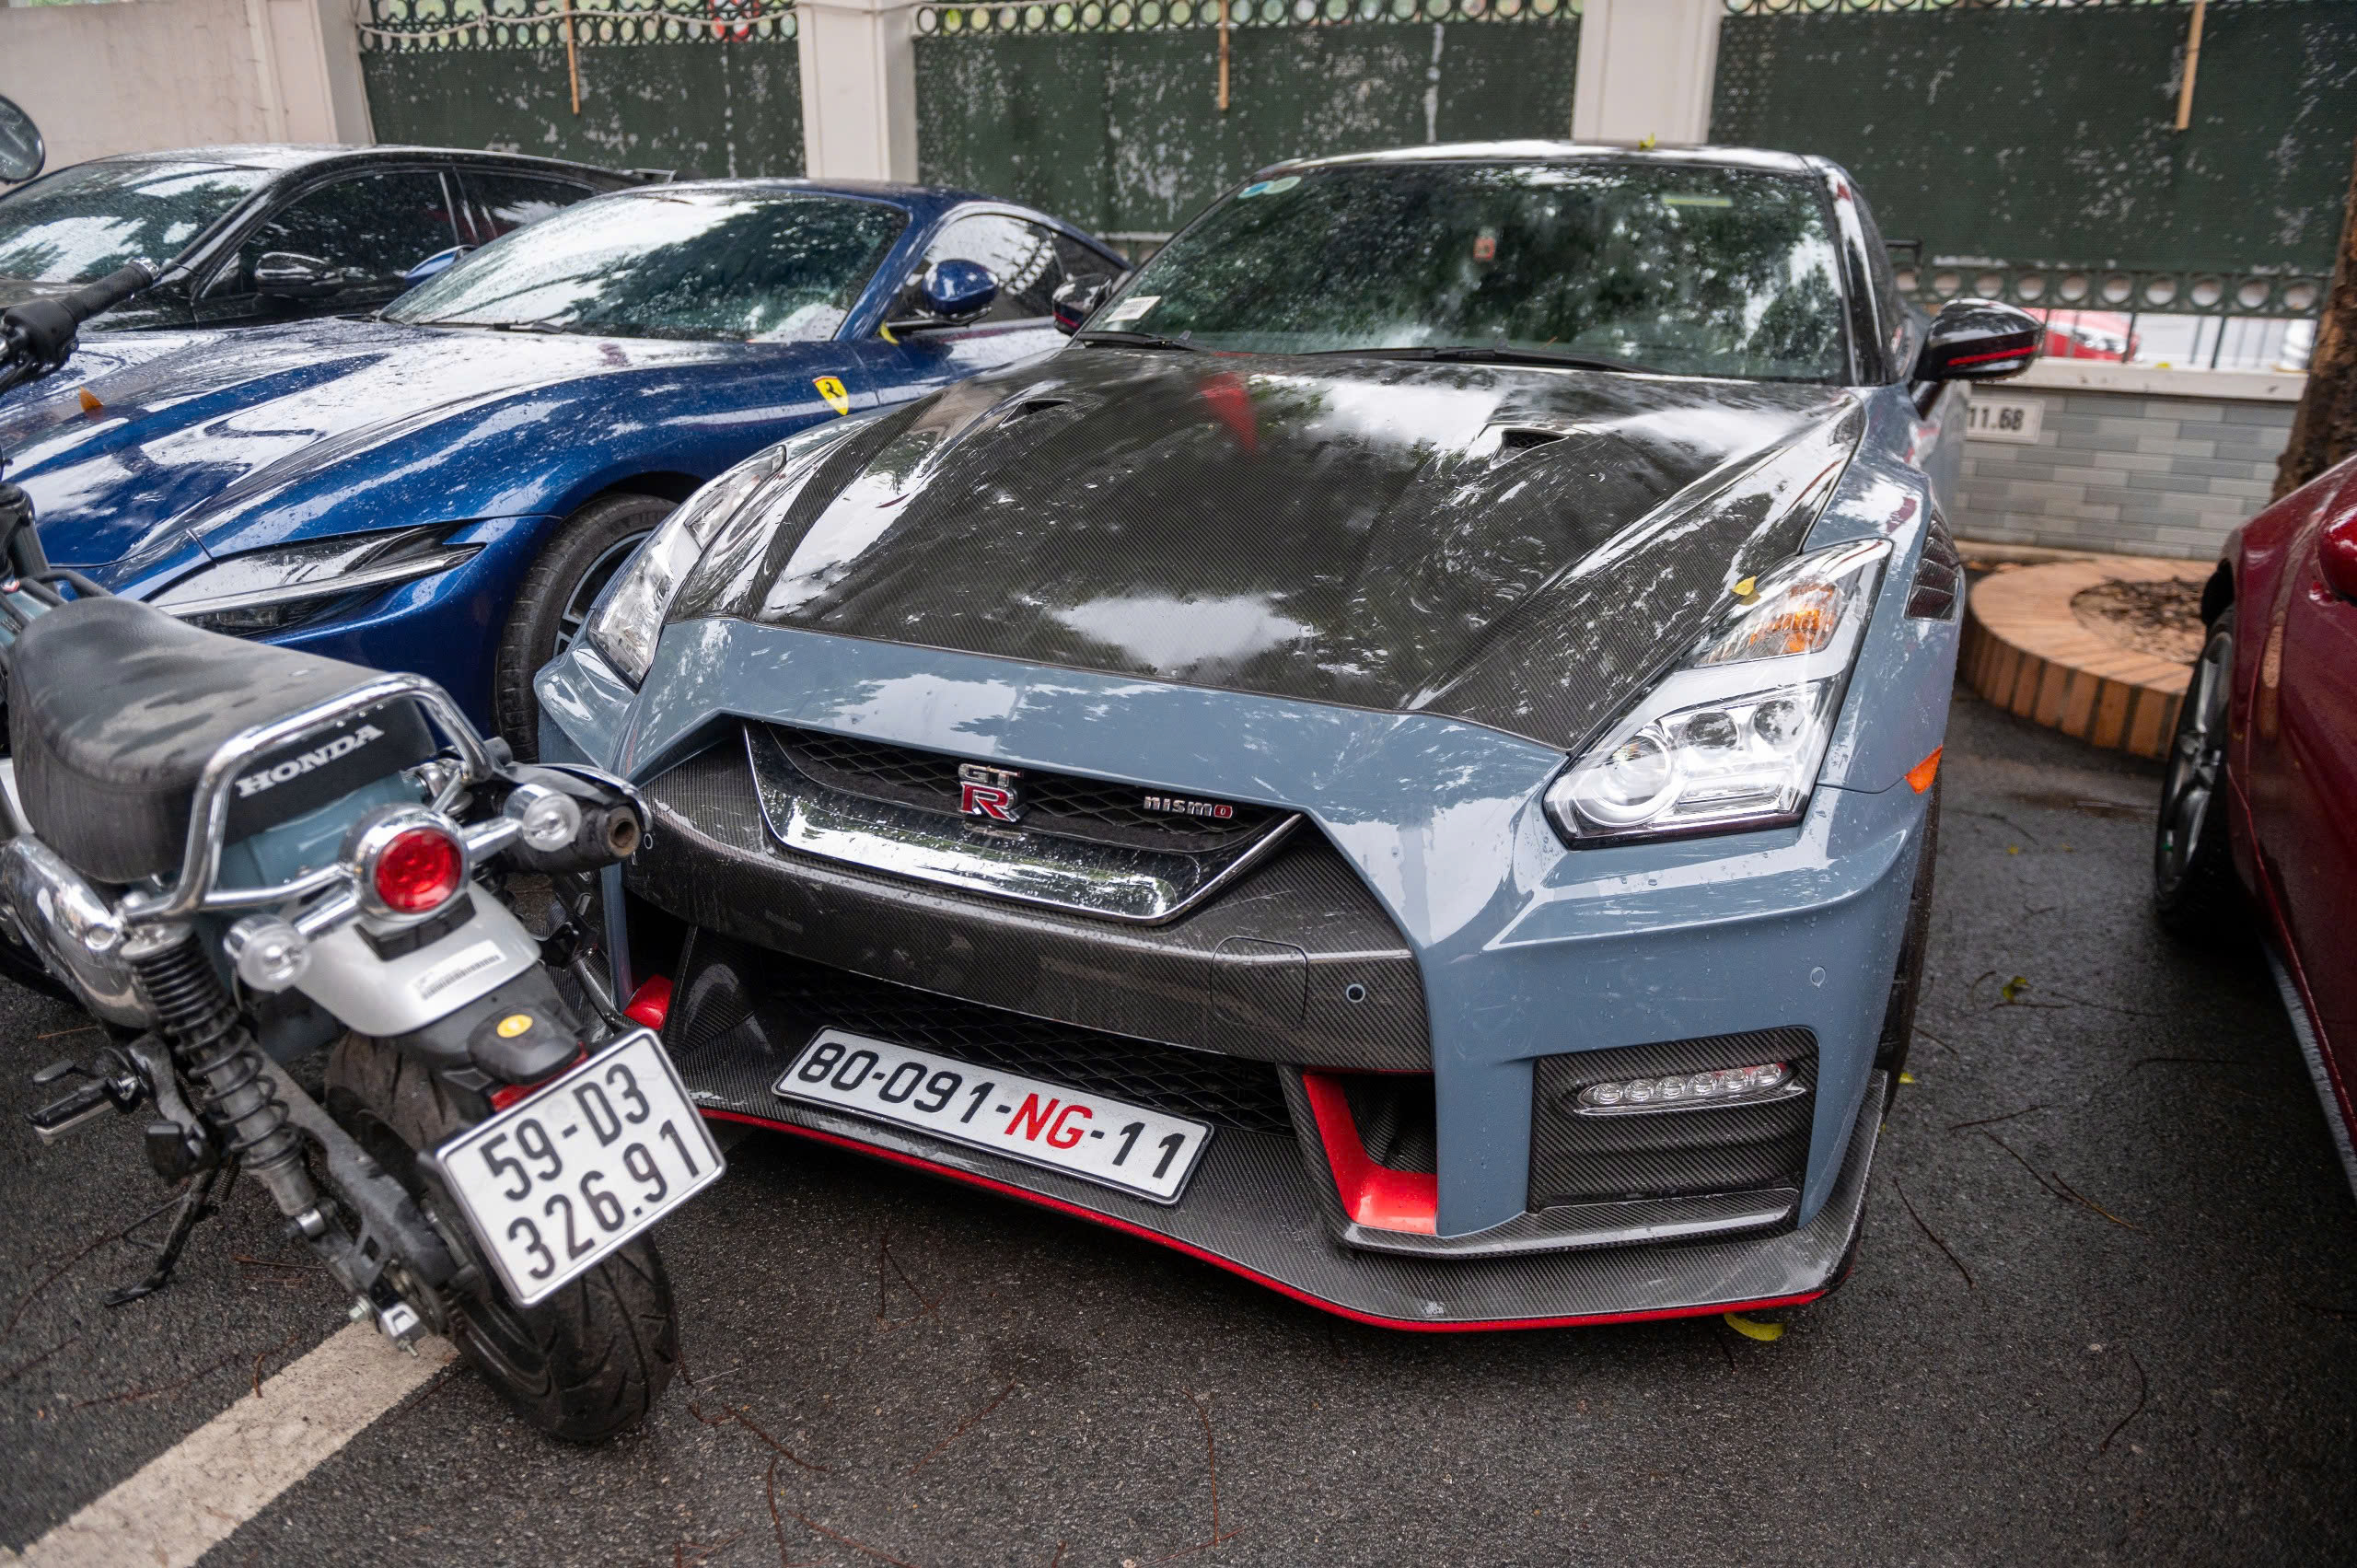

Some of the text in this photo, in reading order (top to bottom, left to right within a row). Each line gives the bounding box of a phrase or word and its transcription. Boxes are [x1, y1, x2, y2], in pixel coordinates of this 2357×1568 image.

[235, 724, 385, 798] HONDA
[958, 763, 1024, 787] GT
[959, 781, 1021, 823] R
[479, 1063, 650, 1202] 59-D3
[797, 1041, 1186, 1179] 80-091-NG-11
[507, 1120, 700, 1280] 326.91
